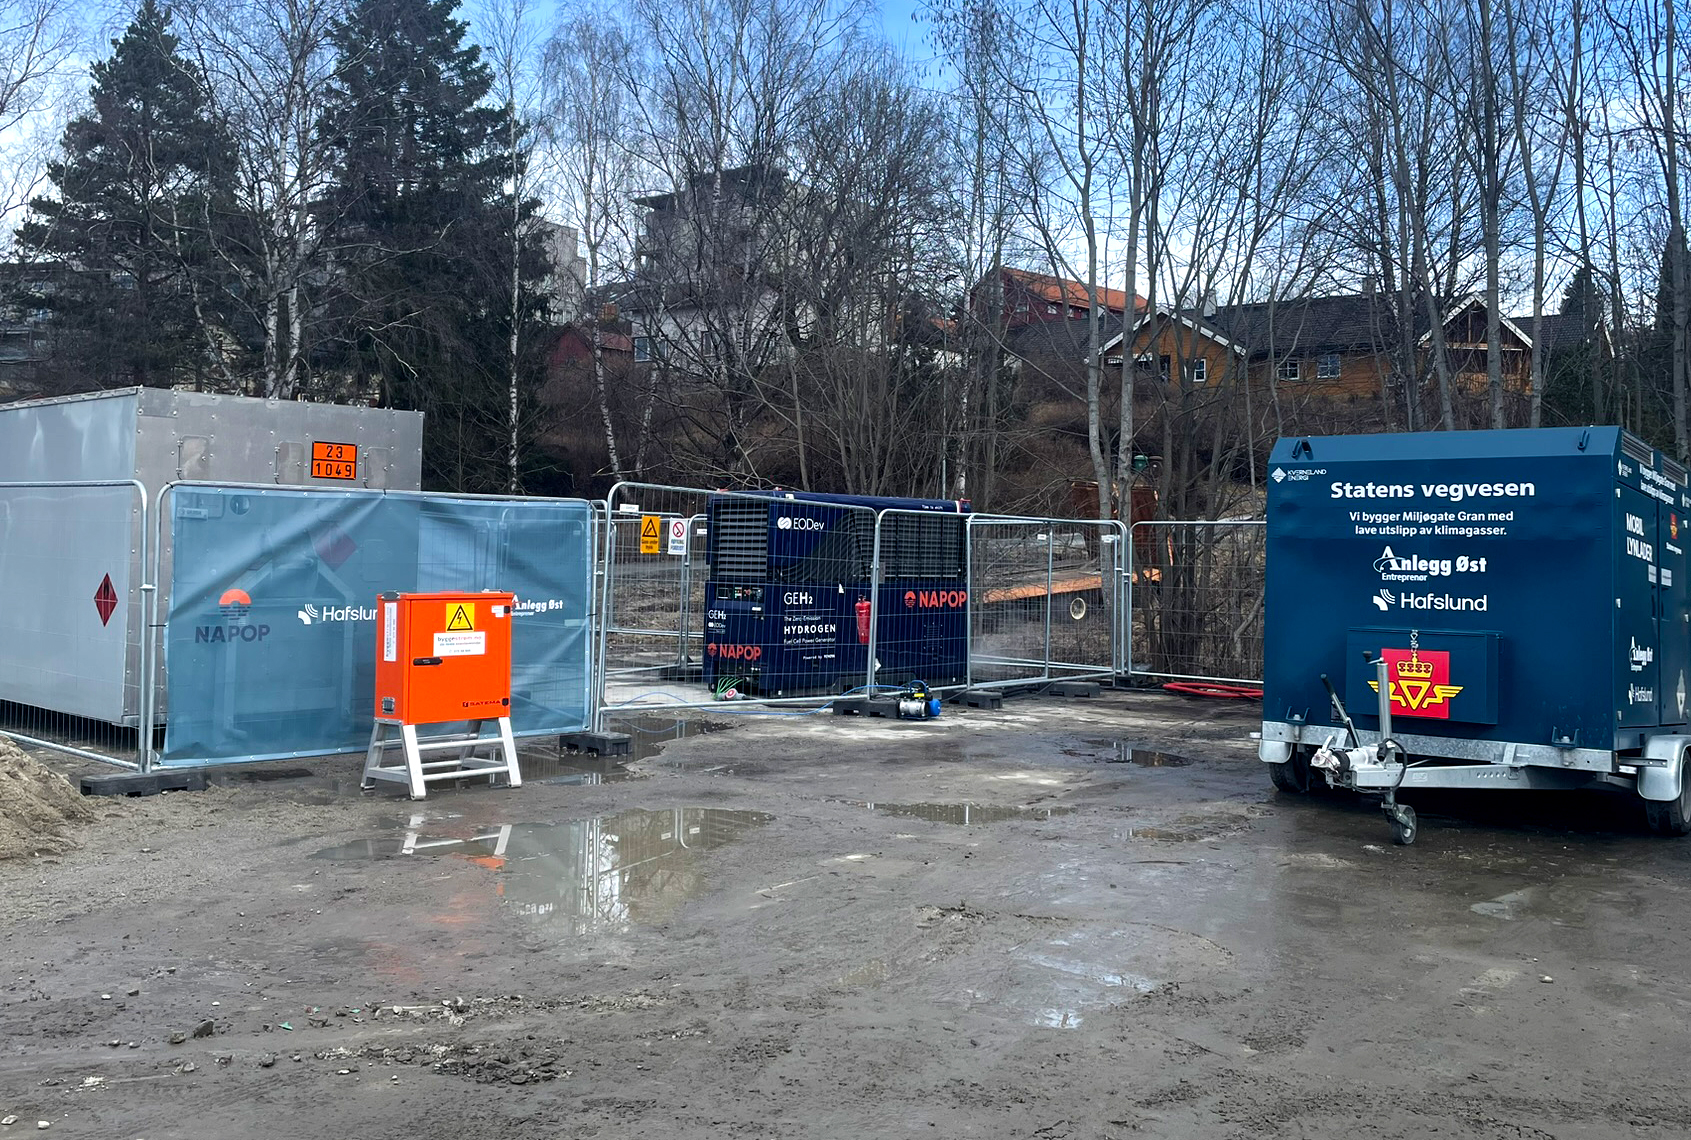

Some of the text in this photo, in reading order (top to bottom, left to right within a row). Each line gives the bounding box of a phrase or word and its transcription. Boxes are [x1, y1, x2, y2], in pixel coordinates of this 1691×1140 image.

[326, 445, 343, 459] 23
[315, 463, 352, 477] 1049
[1330, 482, 1535, 501] Statens vegvesen
[793, 518, 825, 530] EODev
[1349, 511, 1514, 524] Vi bygger Miljøgate Gran med
[1626, 512, 1645, 536] MOBIL
[1355, 524, 1507, 537] lave utslipp av klimagasser.
[1626, 536, 1653, 563] LYNLADER
[1374, 545, 1487, 576] Anlegg Øst
[548, 599, 563, 610] Øst
[919, 591, 967, 608] NAPOP
[1400, 592, 1488, 612] Hafslund
[195, 624, 270, 643] NAPOP
[783, 624, 836, 635] HYDROGEN
[720, 644, 762, 660] NAPOP
